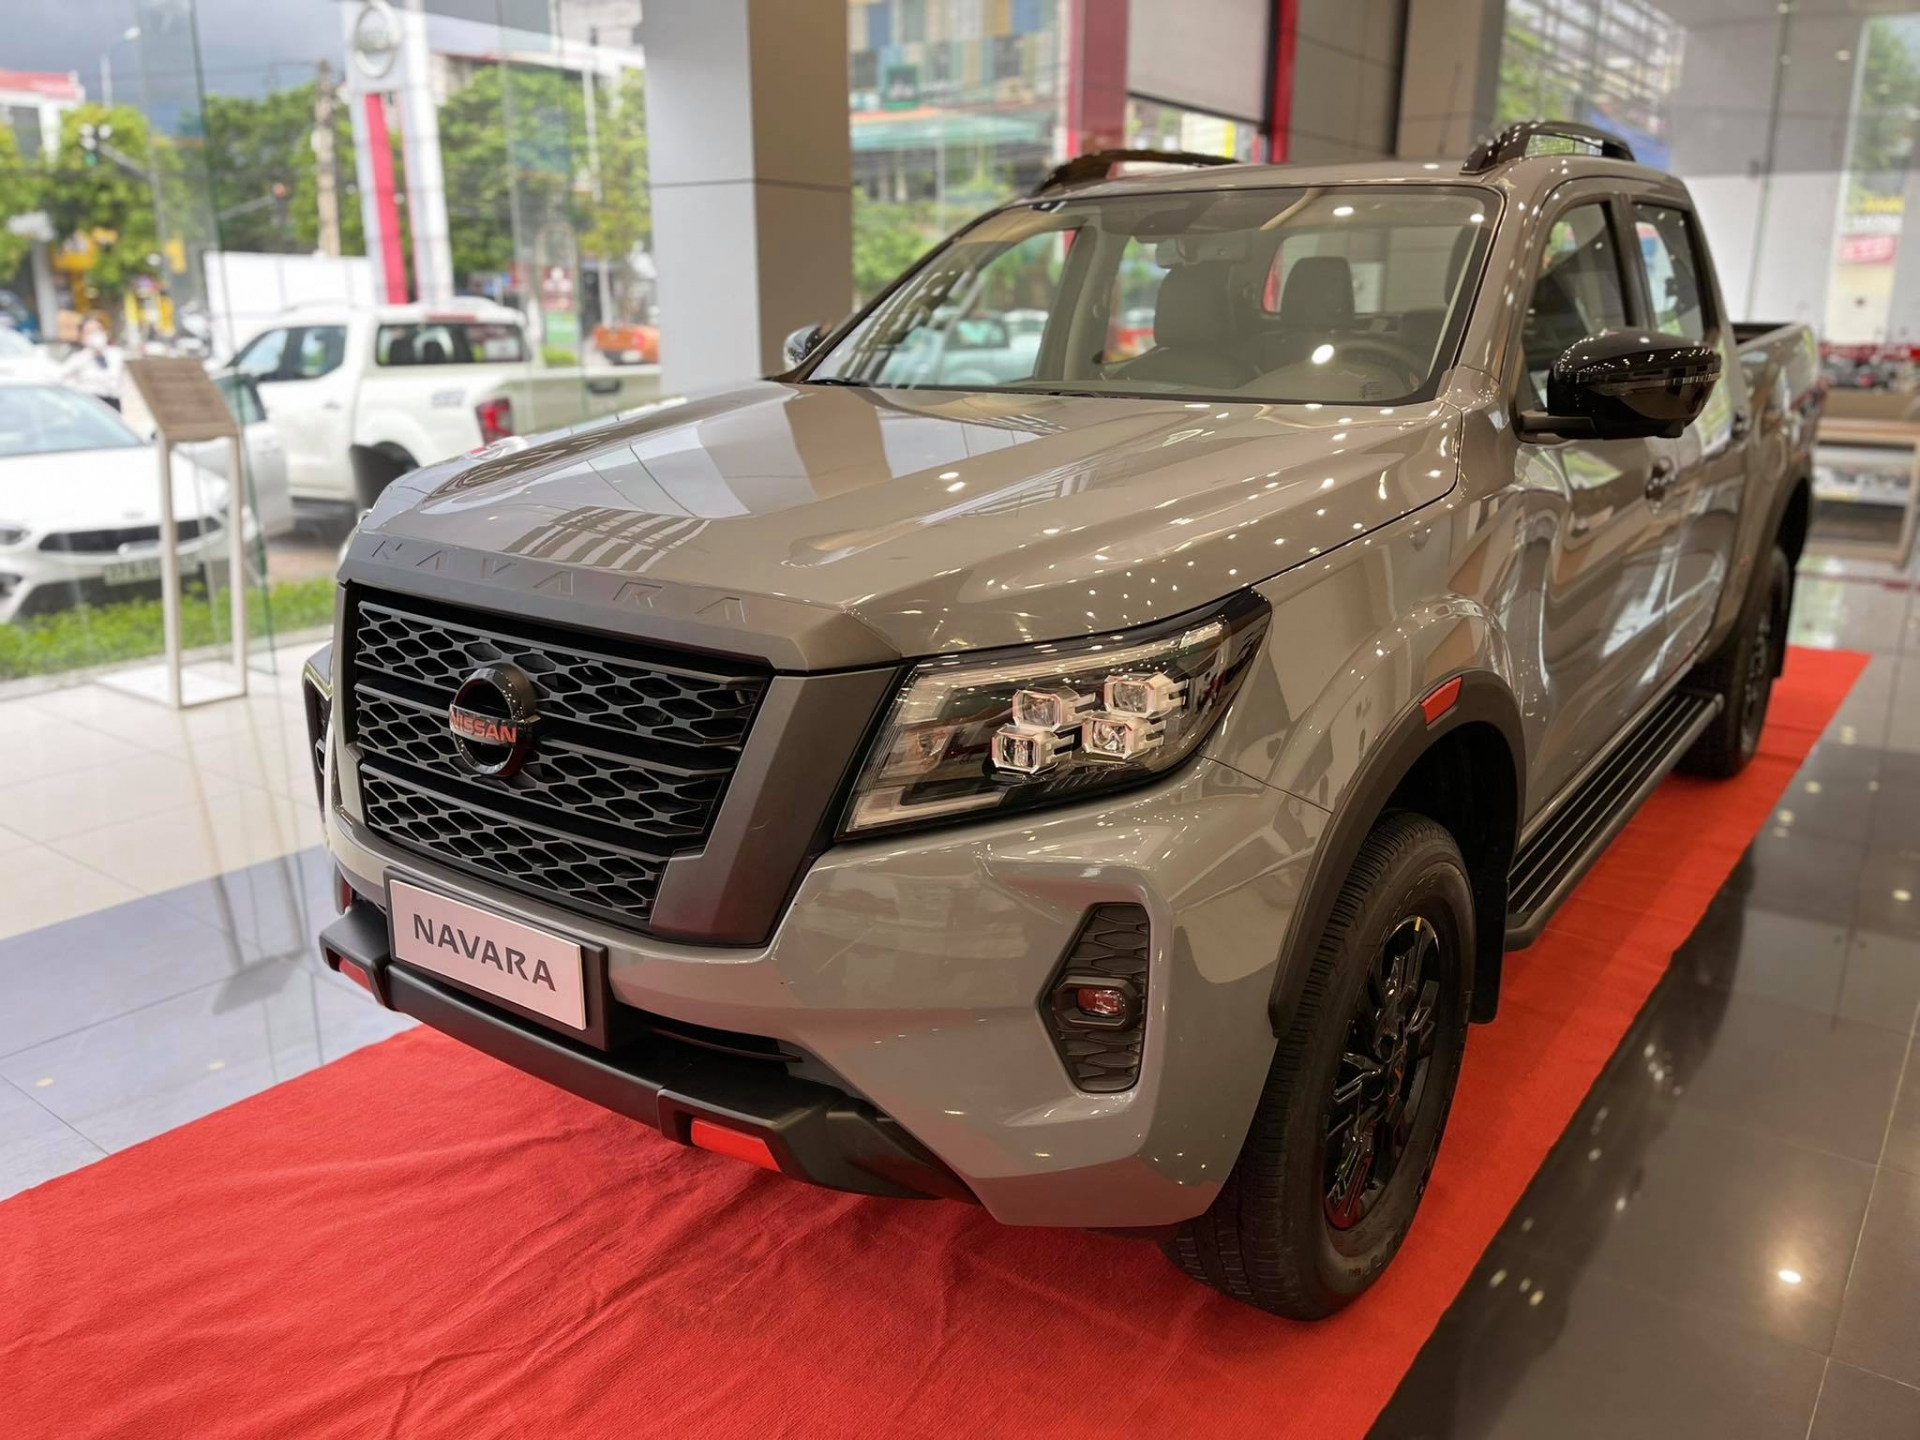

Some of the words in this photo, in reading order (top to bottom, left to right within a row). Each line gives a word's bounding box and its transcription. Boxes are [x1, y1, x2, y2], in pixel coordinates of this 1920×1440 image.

[371, 539, 747, 625] NAVARA
[451, 706, 517, 743] NISSAN
[413, 913, 556, 992] NAVARA
